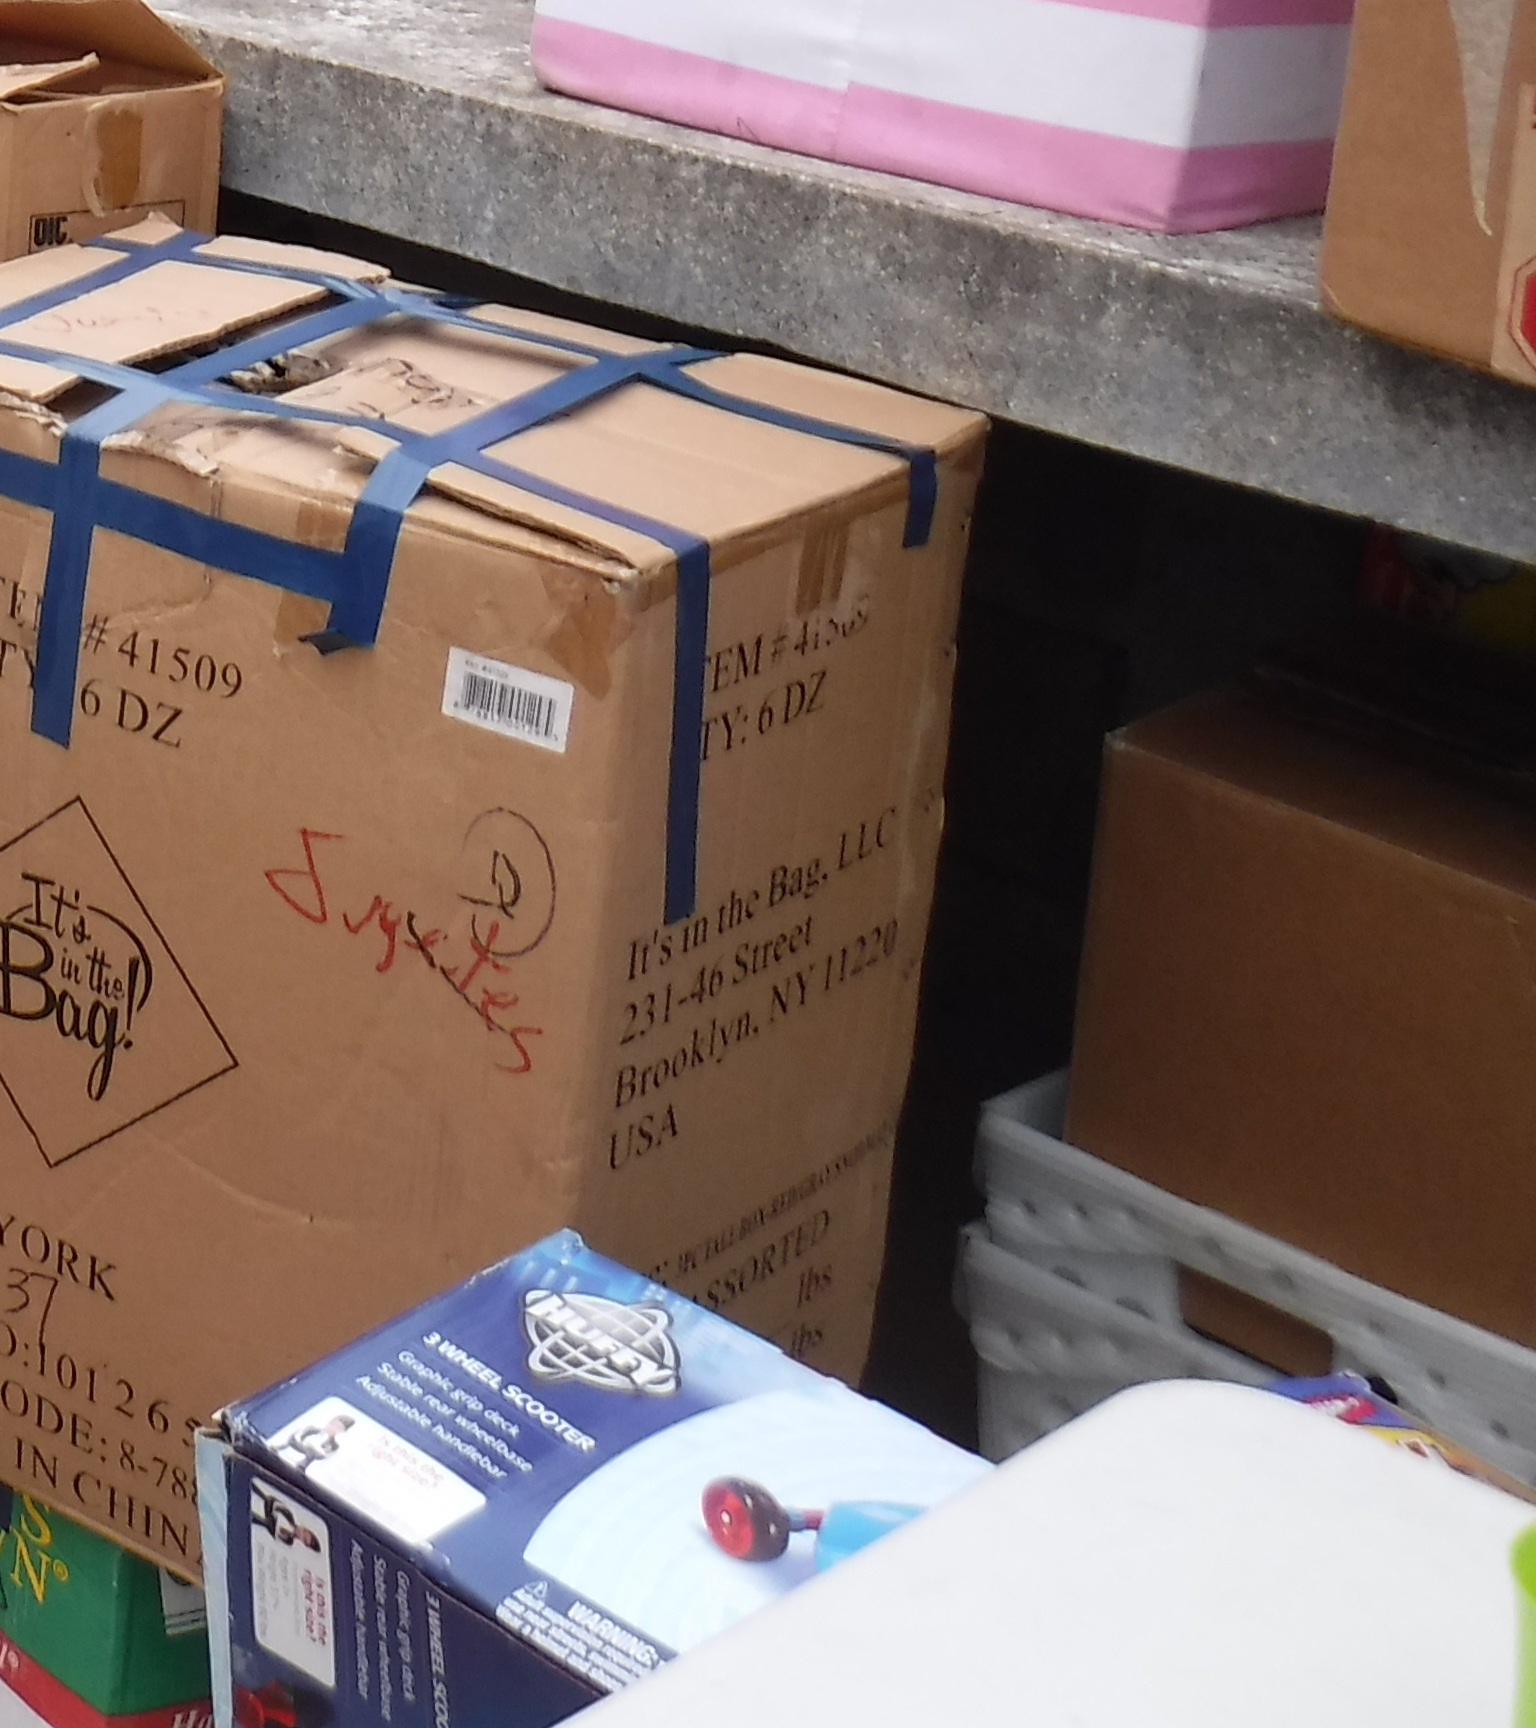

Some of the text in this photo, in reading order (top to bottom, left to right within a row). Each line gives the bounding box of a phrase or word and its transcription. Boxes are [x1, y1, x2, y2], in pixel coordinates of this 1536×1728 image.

[80, 678, 103, 717] 6
[116, 687, 184, 748] DZ
[118, 631, 242, 699] 41509
[758, 688, 777, 735] 6
[784, 670, 827, 724] DZ
[21, 872, 91, 944] It's
[627, 928, 673, 982] It's
[681, 912, 710, 954] in
[716, 888, 760, 935] the
[836, 805, 896, 871] LLC
[60, 946, 126, 1001] in the
[619, 915, 814, 1045] 231-46 Street
[770, 963, 815, 1023] NY
[824, 917, 899, 992] 11220
[608, 1103, 678, 1170] USA
[694, 1209, 830, 1308] SSORTED
[525, 1292, 674, 1389] HUFFY
[356, 1374, 508, 1479] Adjustable handlebar
[377, 1361, 534, 1473] Stable rear wheelbase
[397, 1350, 521, 1438] Graphic grip deck
[422, 1330, 597, 1453] 3 WHEEL SCOOTER
[16, 1437, 59, 1490] IN
[72, 1470, 190, 1557] CHIN
[427, 1609, 446, 1677] WHEEL
